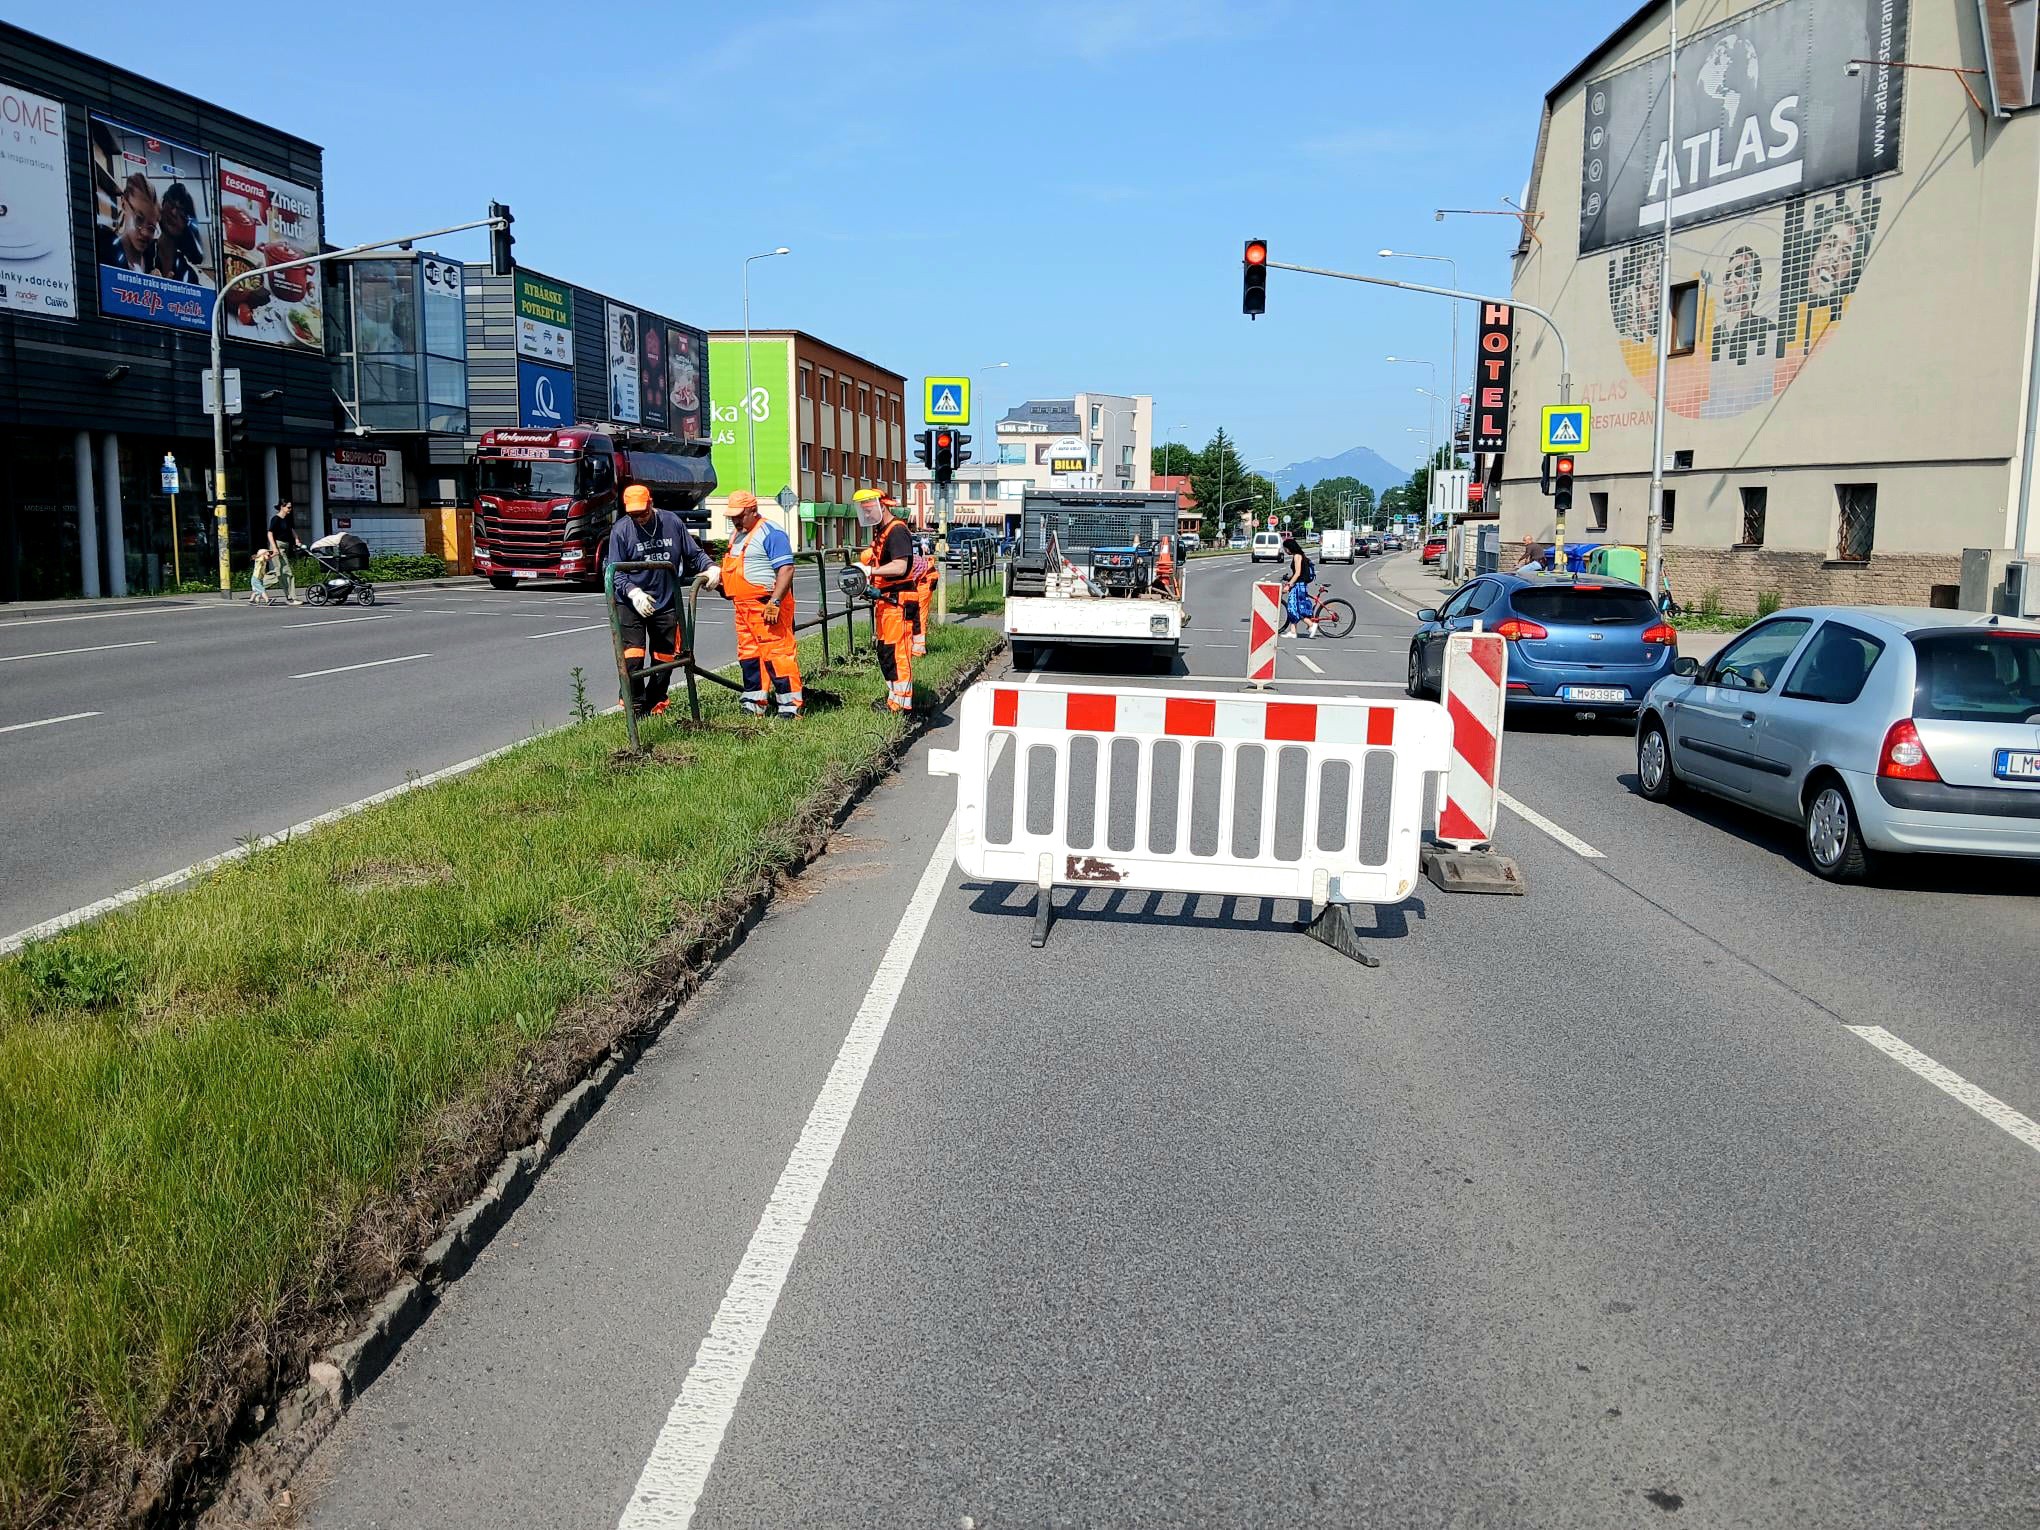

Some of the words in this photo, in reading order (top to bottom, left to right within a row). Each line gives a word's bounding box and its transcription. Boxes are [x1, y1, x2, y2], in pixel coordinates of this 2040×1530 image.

[1873, 0, 1893, 158] www.atlasrestauran
[0, 95, 59, 136] OME
[1648, 95, 1799, 197] ATLAS
[270, 188, 312, 218] Zmena
[524, 282, 563, 305] RYBÁRSKE
[522, 300, 555, 321] POTREBY
[1482, 304, 1509, 435] HOTEL
[1581, 380, 1628, 404] ATLAS
[1590, 410, 1655, 430] RESTAURAN
[1054, 459, 1083, 470] BILLA
[635, 537, 673, 552] BELOW
[643, 551, 671, 561] ZERO
[2009, 755, 2034, 774] LM
